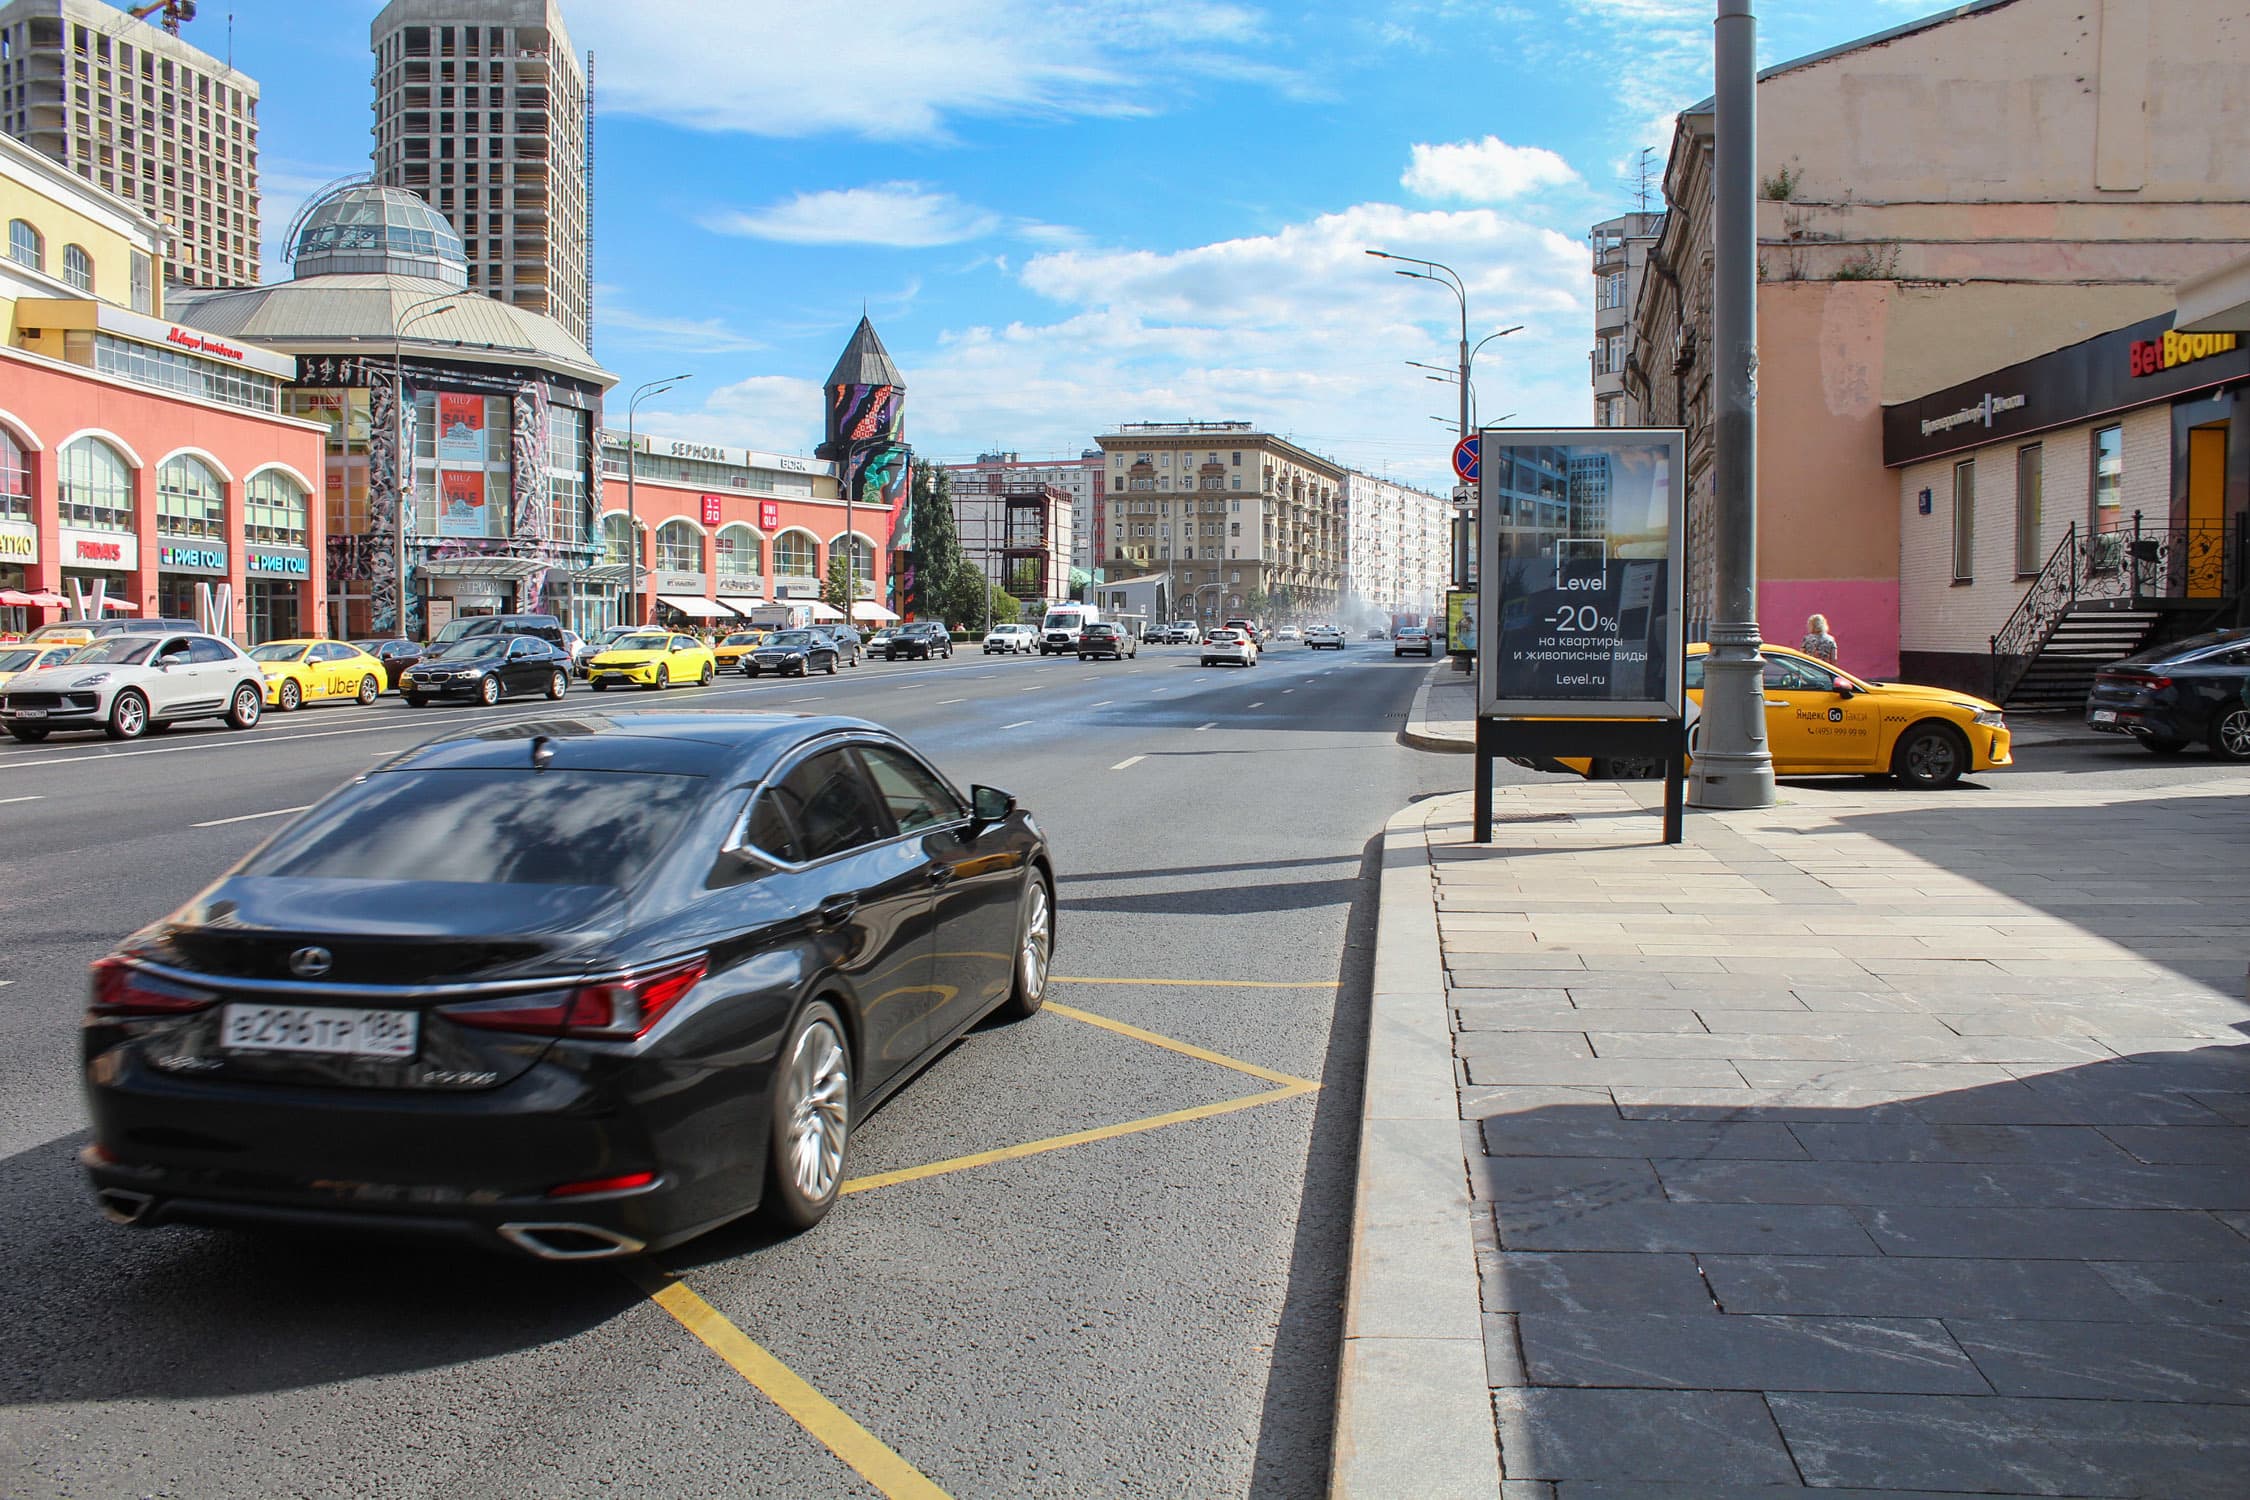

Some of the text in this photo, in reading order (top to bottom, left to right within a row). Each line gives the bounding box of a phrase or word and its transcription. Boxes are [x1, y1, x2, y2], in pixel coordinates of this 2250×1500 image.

[2130, 329, 2236, 378] BetBoom
[671, 441, 726, 462] SEPHORA
[780, 458, 807, 472] BORK
[764, 504, 776, 514] UNI
[764, 516, 777, 526] QLO
[174, 549, 224, 568] РИВ ГОШ
[260, 555, 306, 573] РИВ ГОШ
[1556, 570, 1607, 591] Level
[1544, 605, 1618, 632] -20%
[1538, 637, 1624, 650] на квартиры
[1513, 651, 1649, 663] и живописные виды
[327, 676, 360, 695] Uber
[1556, 673, 1606, 685] Level.ru
[1796, 708, 1826, 721] Яндекс
[1828, 709, 1842, 721] Go
